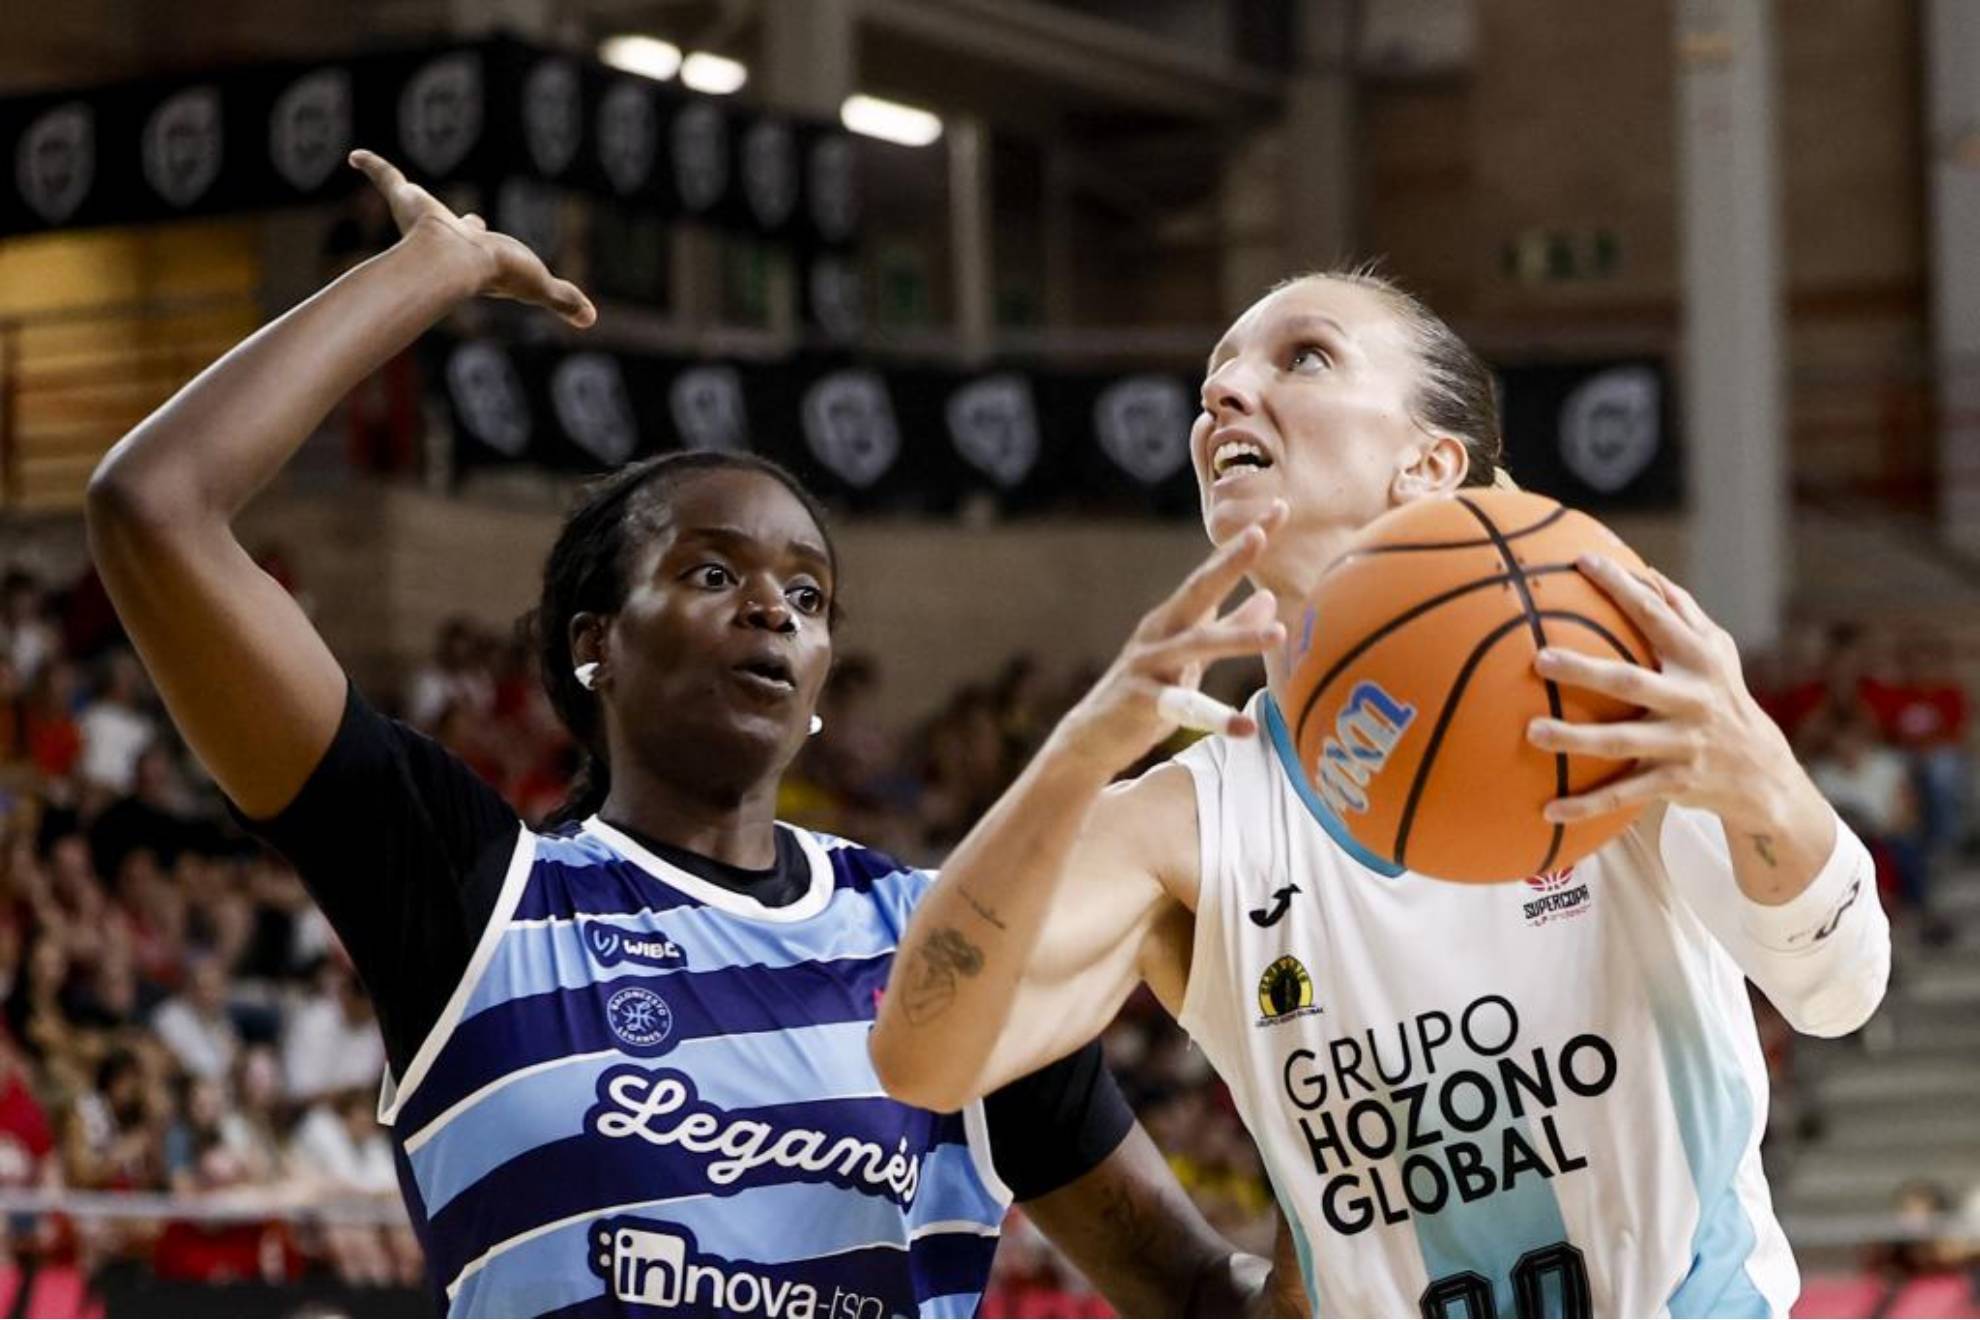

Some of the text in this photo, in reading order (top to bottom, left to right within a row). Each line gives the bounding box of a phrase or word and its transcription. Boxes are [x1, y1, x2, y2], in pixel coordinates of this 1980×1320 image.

[1284, 995, 1519, 1111] GRUPO
[1299, 1034, 1617, 1175] HOZONO
[597, 1074, 920, 1202] Leganés
[1322, 1115, 1588, 1236] GLOBAL
